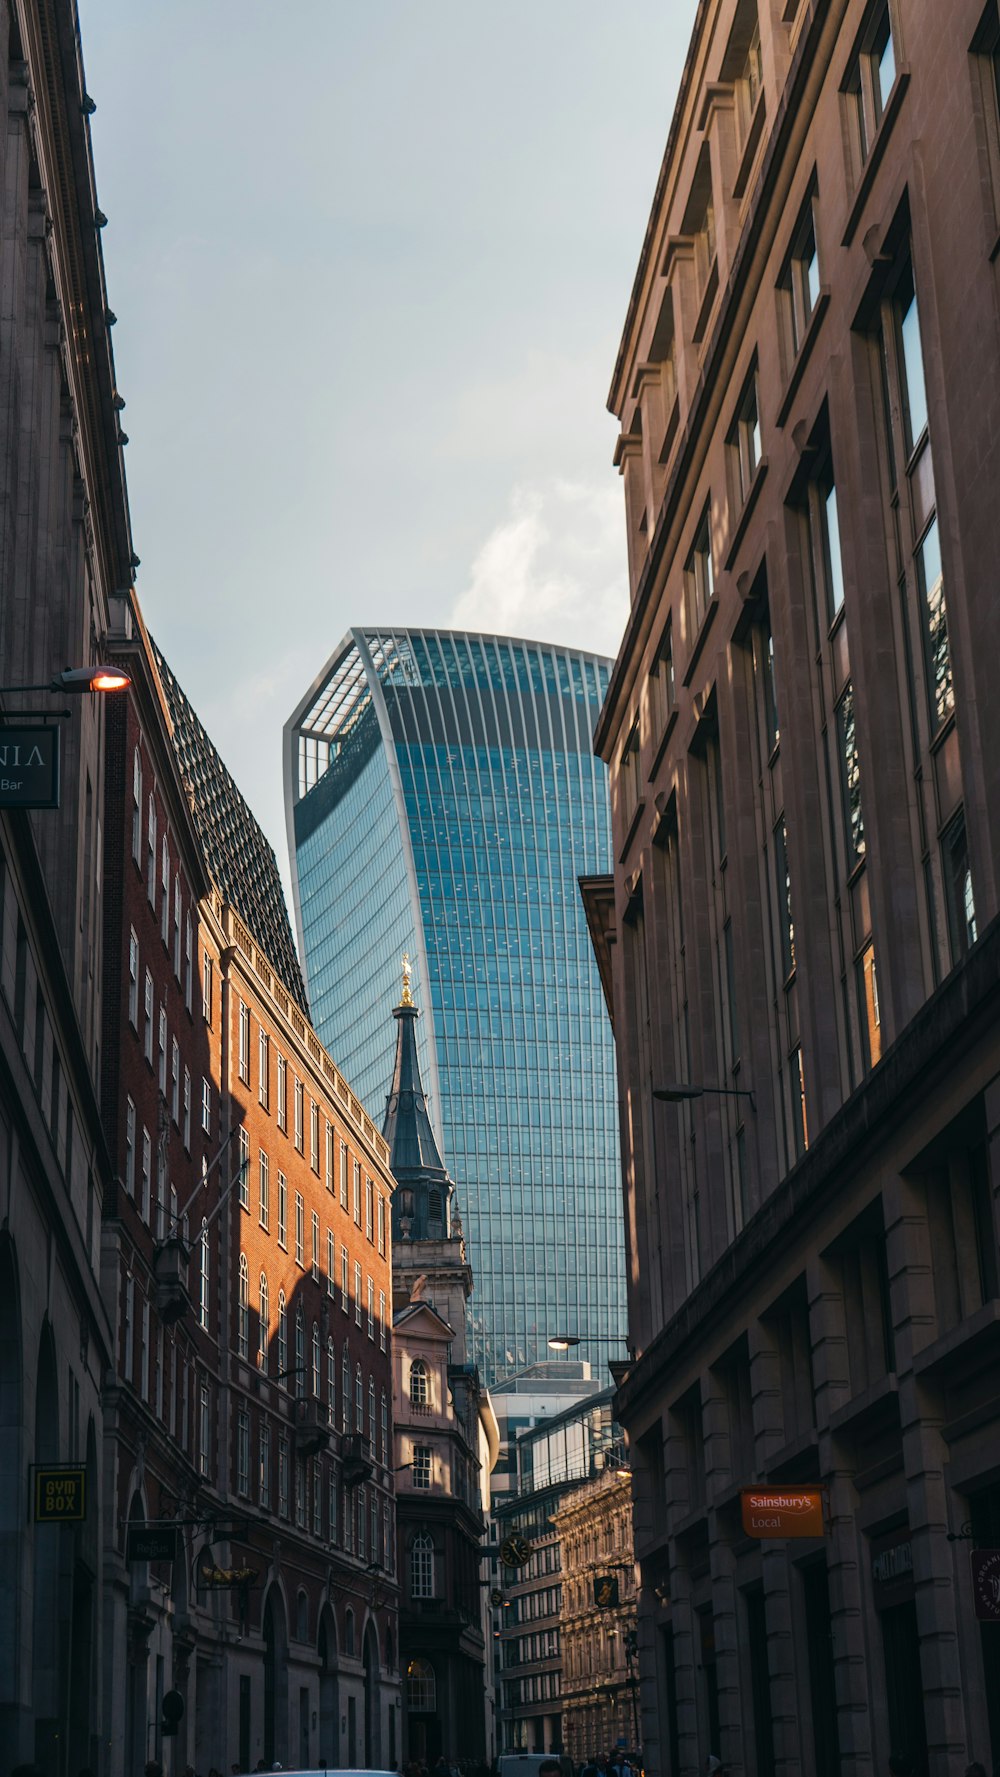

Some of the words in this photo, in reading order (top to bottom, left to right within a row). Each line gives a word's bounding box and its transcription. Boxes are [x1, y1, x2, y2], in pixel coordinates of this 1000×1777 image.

[1, 779, 23, 790] Bar
[46, 1480, 75, 1495] GYM
[46, 1496, 74, 1511] BOX
[750, 1496, 811, 1509] Sainsbury's
[752, 1516, 781, 1528] Local
[137, 1542, 169, 1557] Regus
